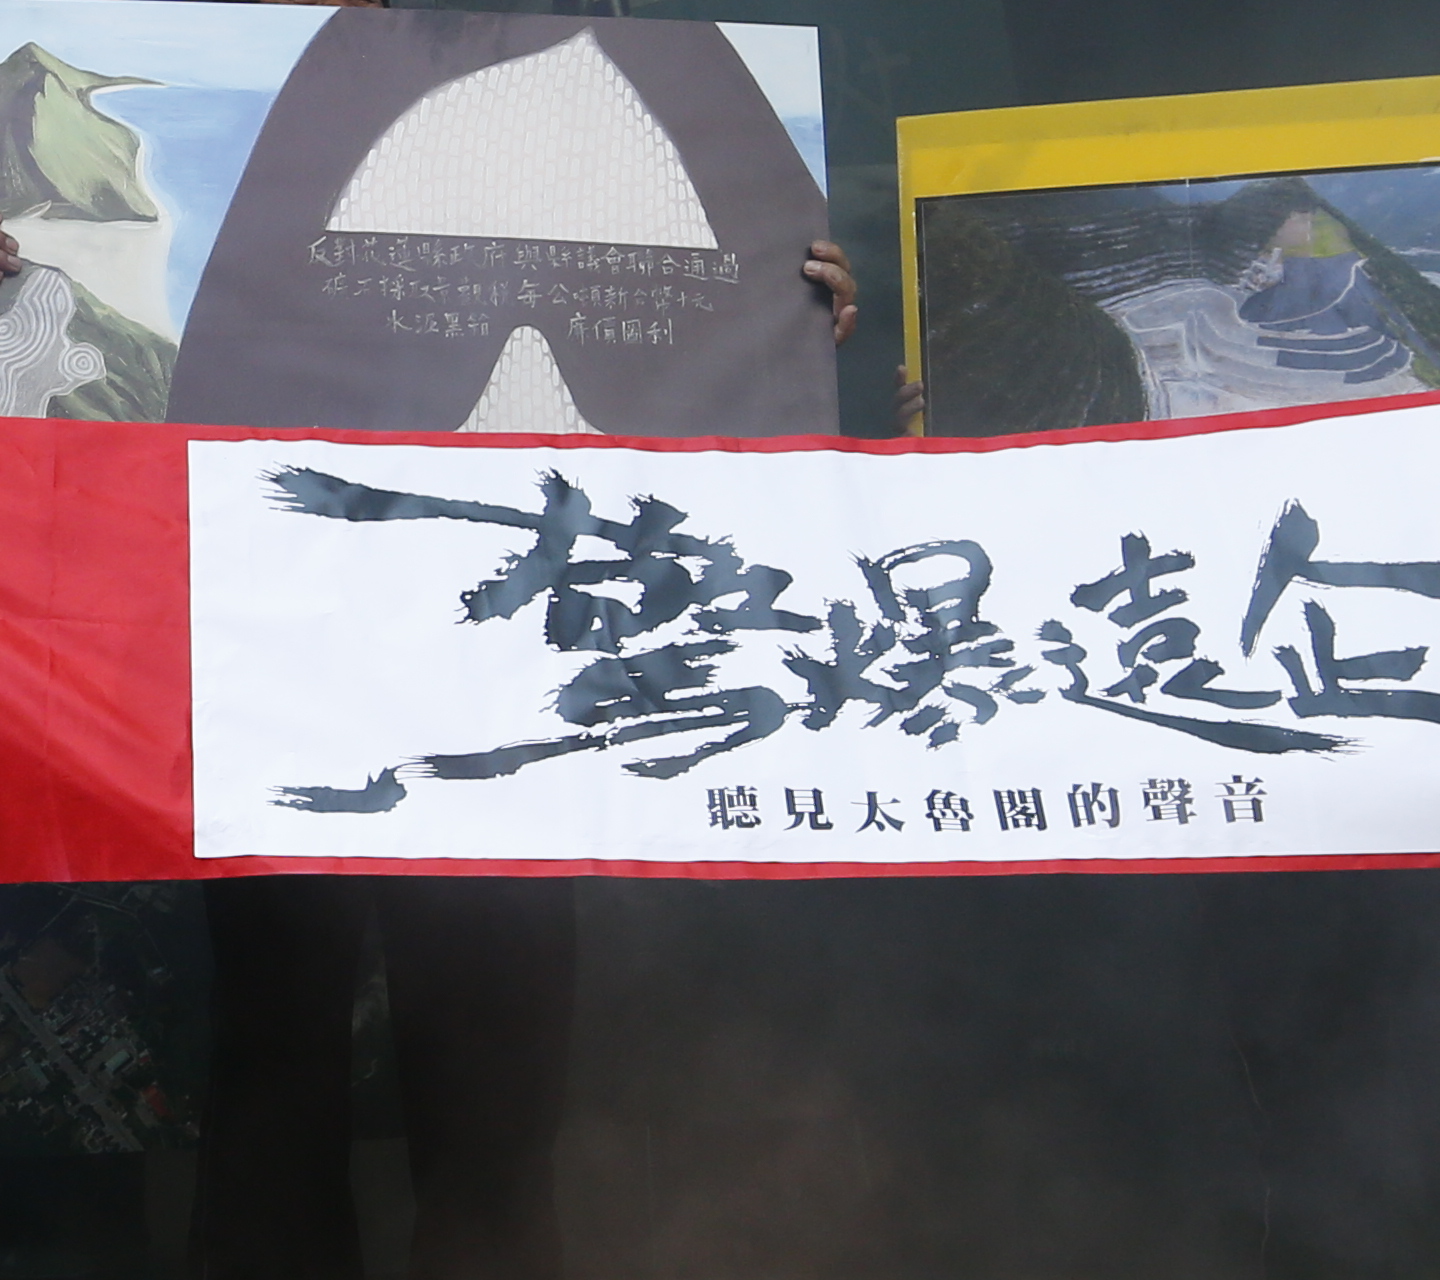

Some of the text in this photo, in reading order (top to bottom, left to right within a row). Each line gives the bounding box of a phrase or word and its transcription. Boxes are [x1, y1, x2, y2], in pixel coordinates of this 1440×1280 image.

[705, 774, 1268, 833] 聽見太魯閣的聲音
